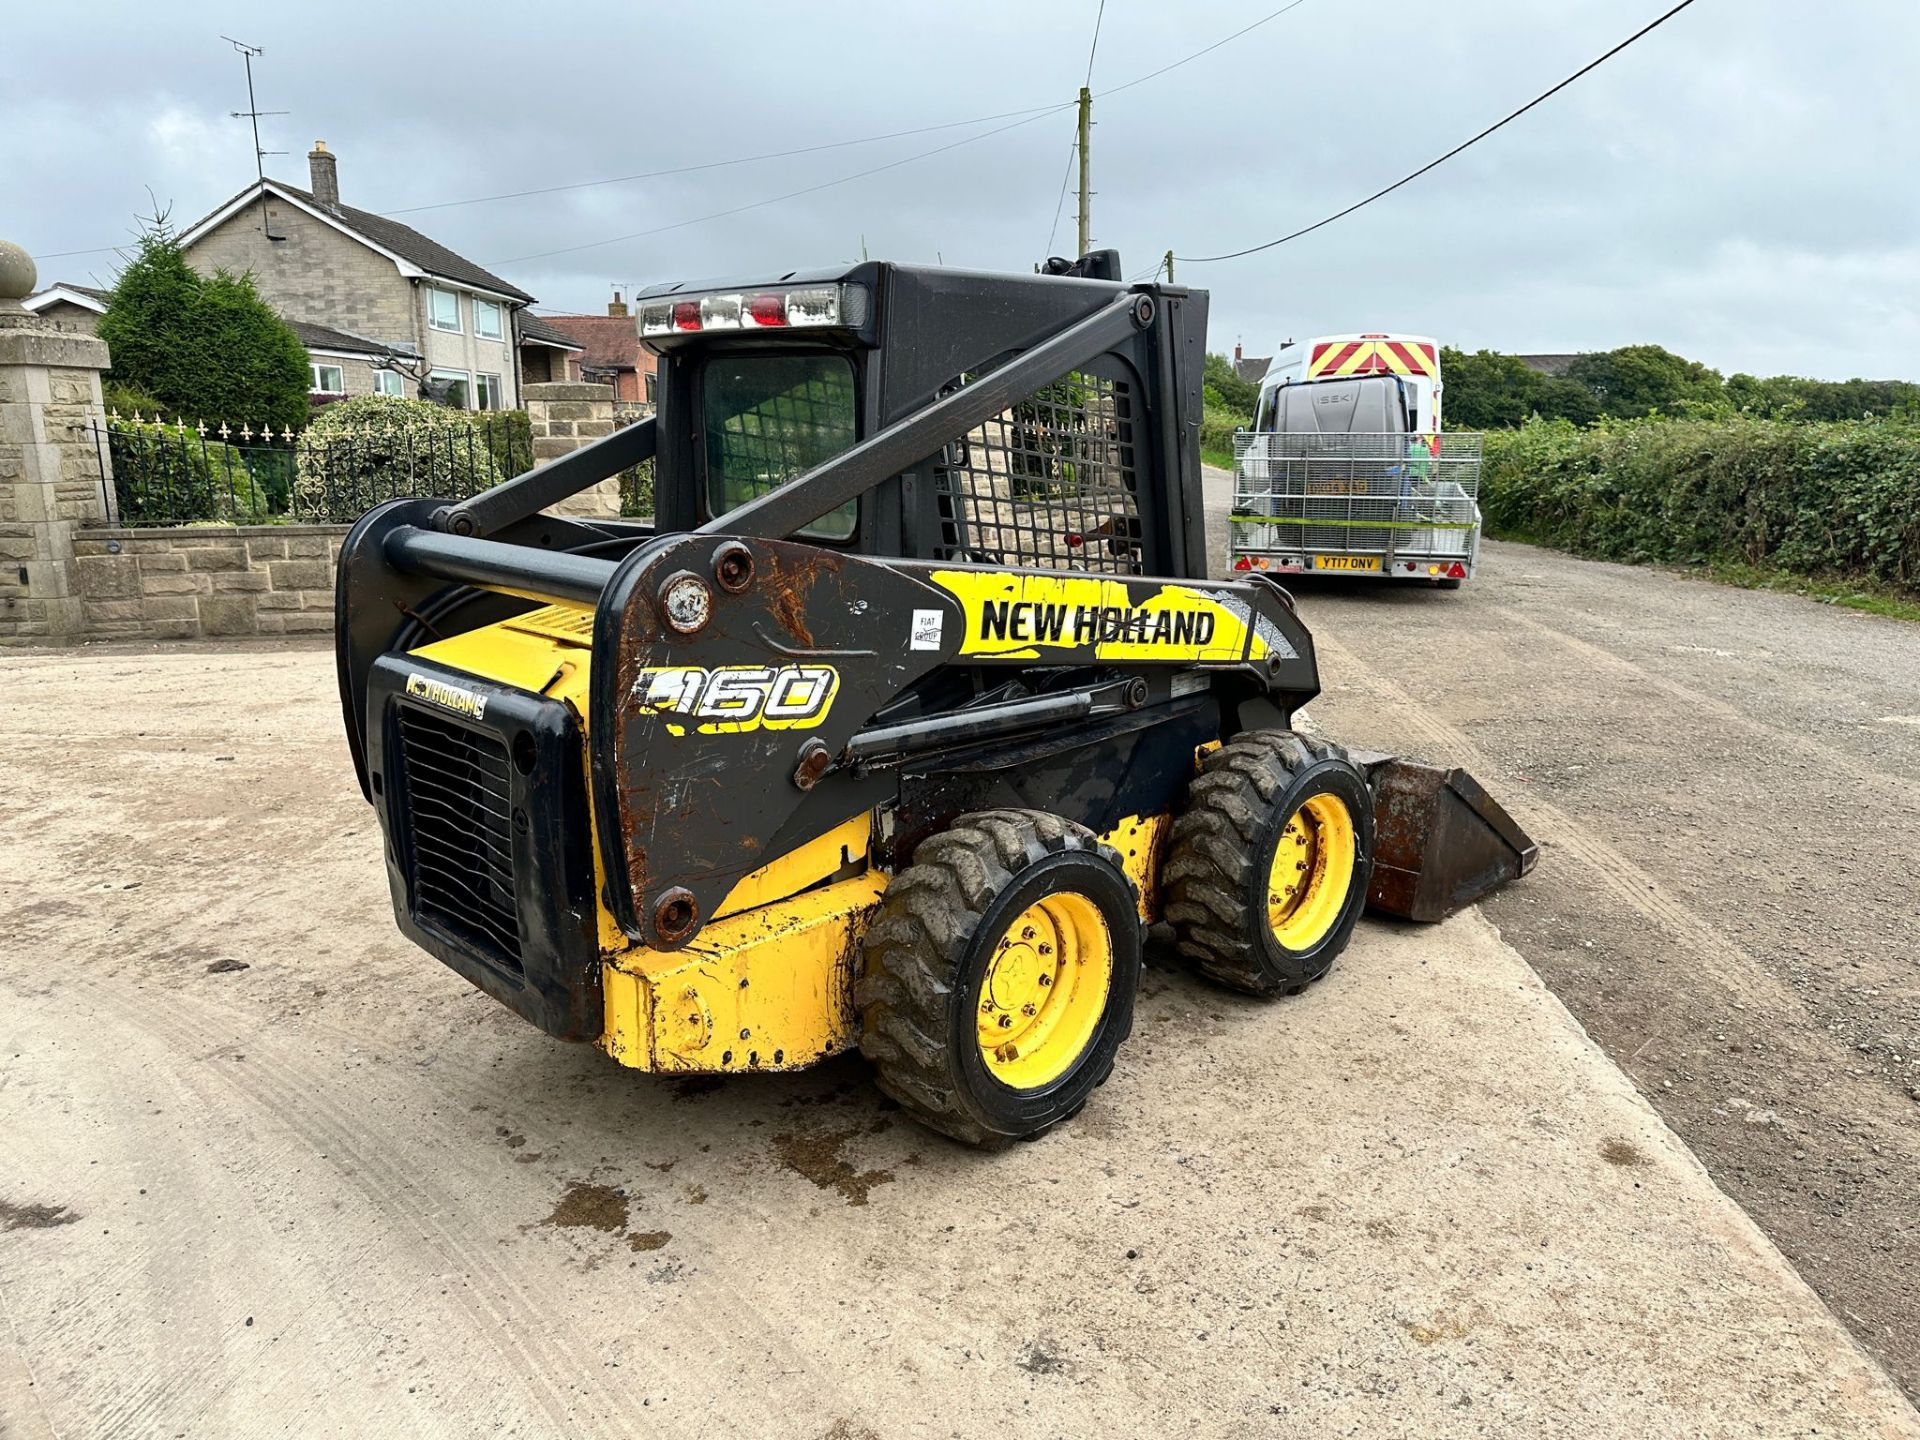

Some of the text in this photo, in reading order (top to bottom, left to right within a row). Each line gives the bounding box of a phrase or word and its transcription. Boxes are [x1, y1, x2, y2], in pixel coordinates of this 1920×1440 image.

[1316, 394, 1354, 405] ISEKI
[1323, 557, 1374, 569] YT17 ONV
[920, 617, 936, 627] FIAT
[980, 599, 1216, 646] NEW HOLLAND
[914, 631, 939, 641] GROUP
